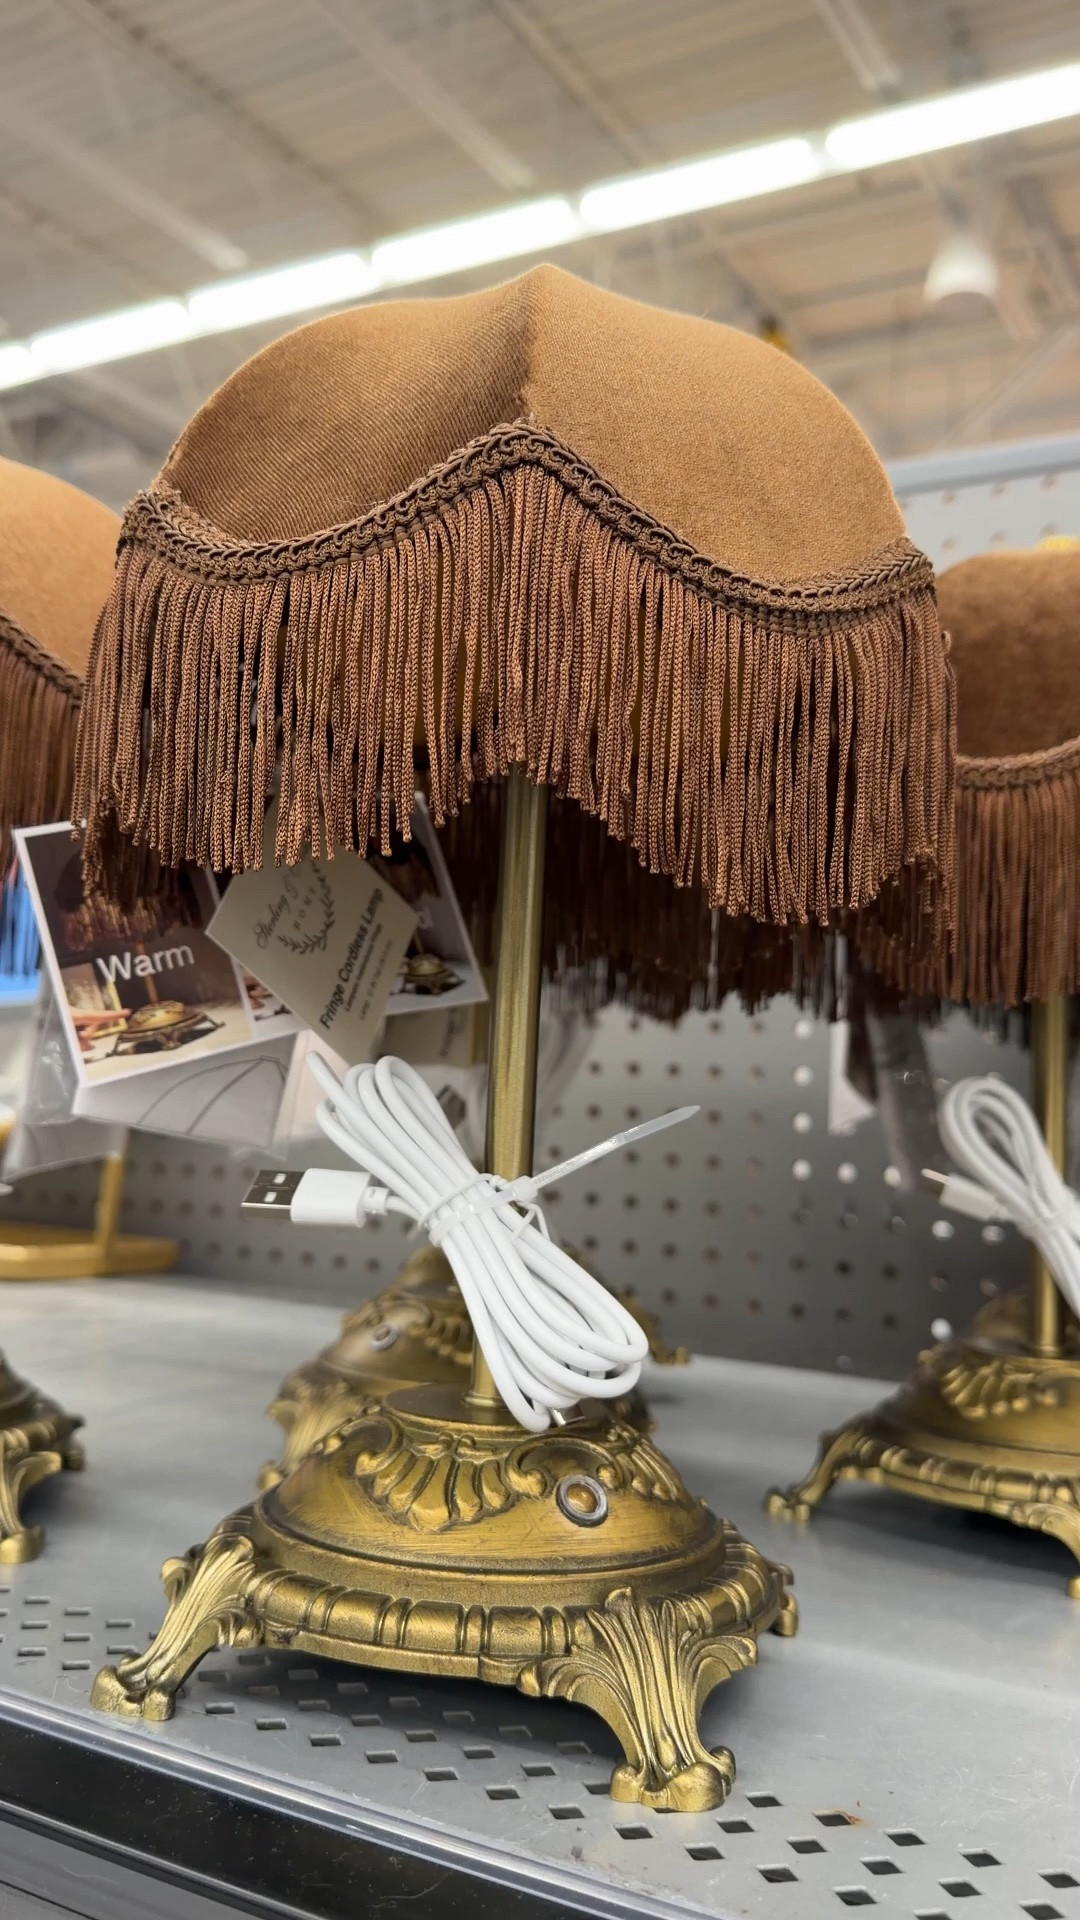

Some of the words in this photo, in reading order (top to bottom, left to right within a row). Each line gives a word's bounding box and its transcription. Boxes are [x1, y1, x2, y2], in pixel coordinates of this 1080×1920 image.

[95, 944, 195, 983] Warm
[319, 983, 346, 1030] Fringe
[338, 923, 370, 983] Cordless
[360, 887, 384, 926] Lamp
